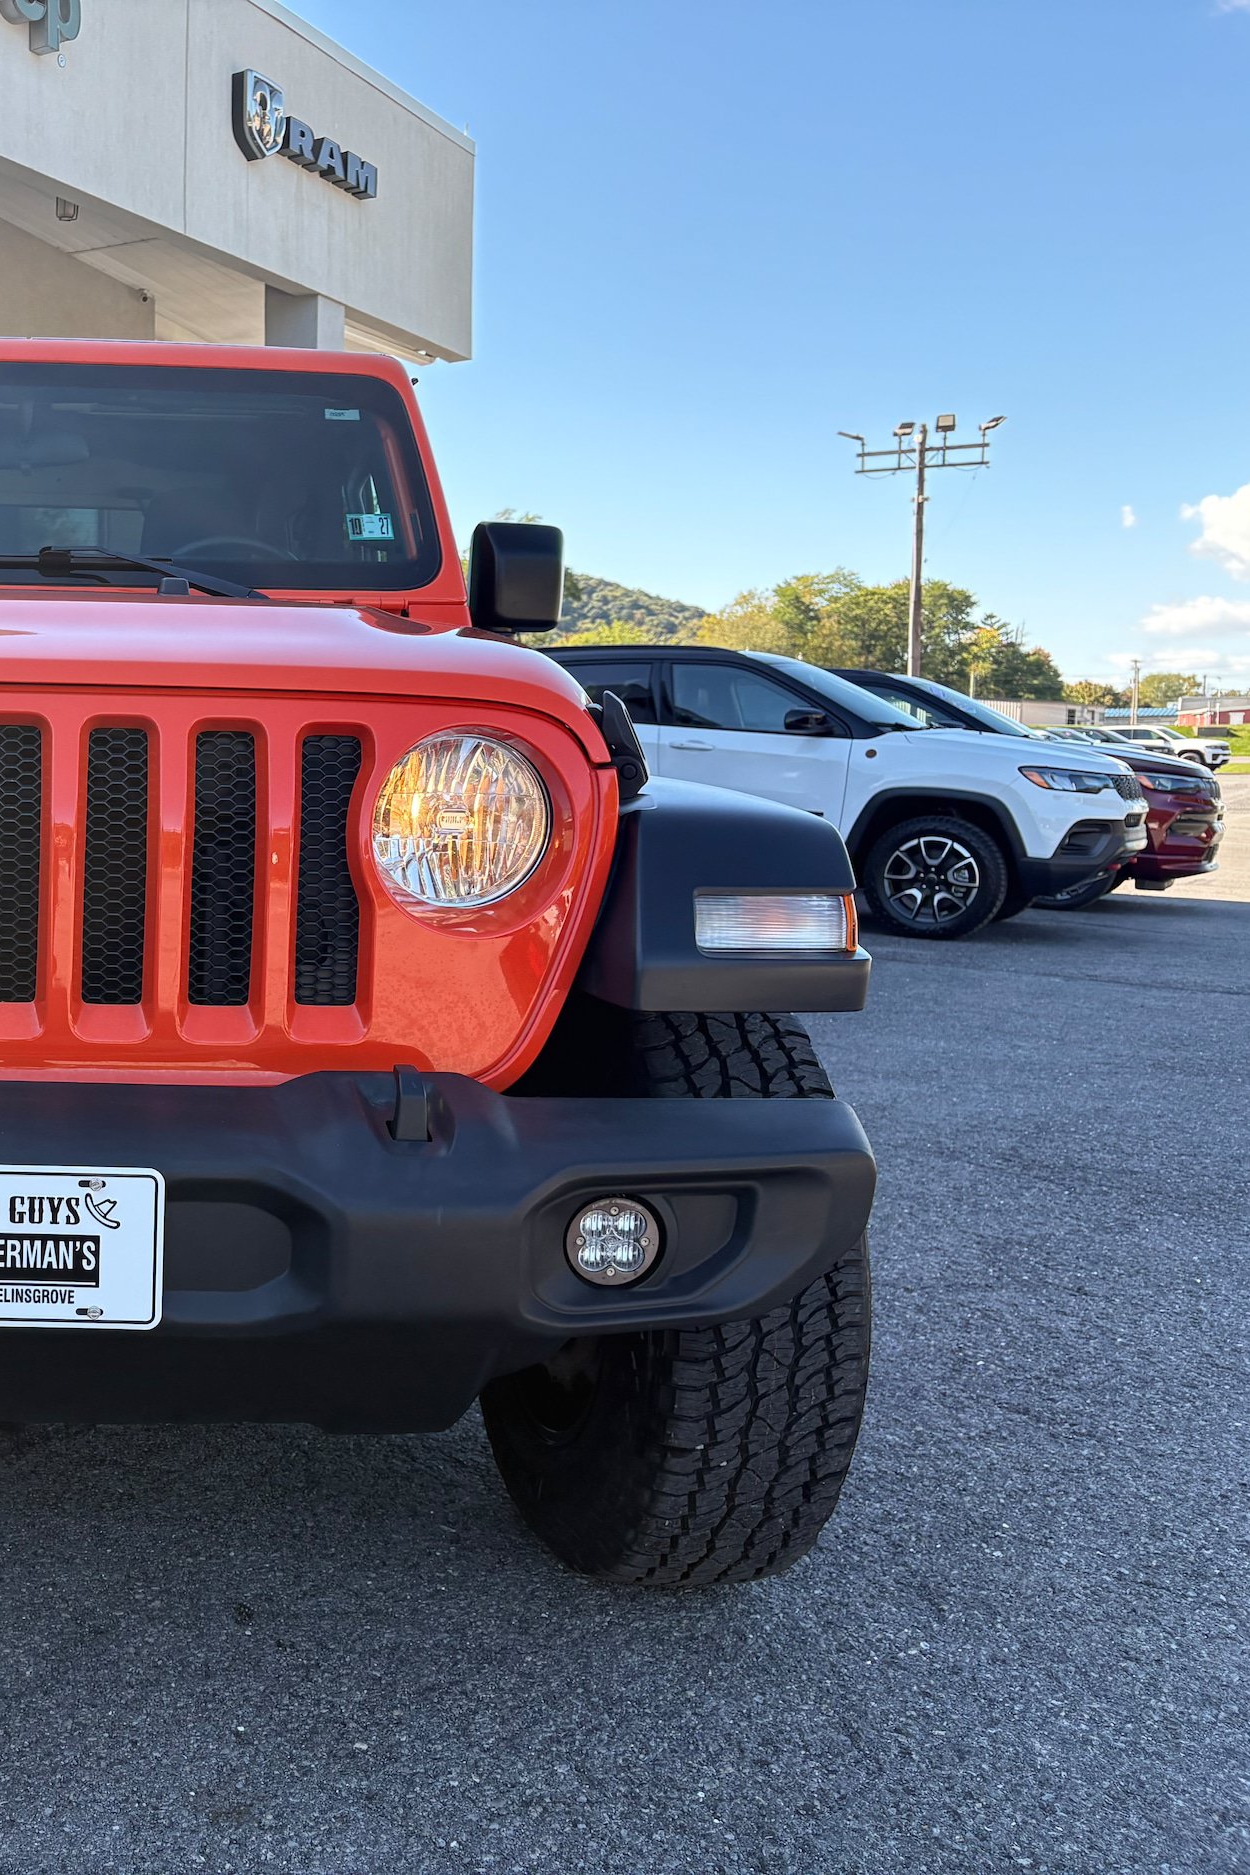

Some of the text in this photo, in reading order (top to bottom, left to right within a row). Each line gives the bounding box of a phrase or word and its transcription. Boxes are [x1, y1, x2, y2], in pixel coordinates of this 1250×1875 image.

[284, 116, 377, 200] RAM
[379, 517, 389, 535] 27
[9, 1195, 81, 1226] GUYS
